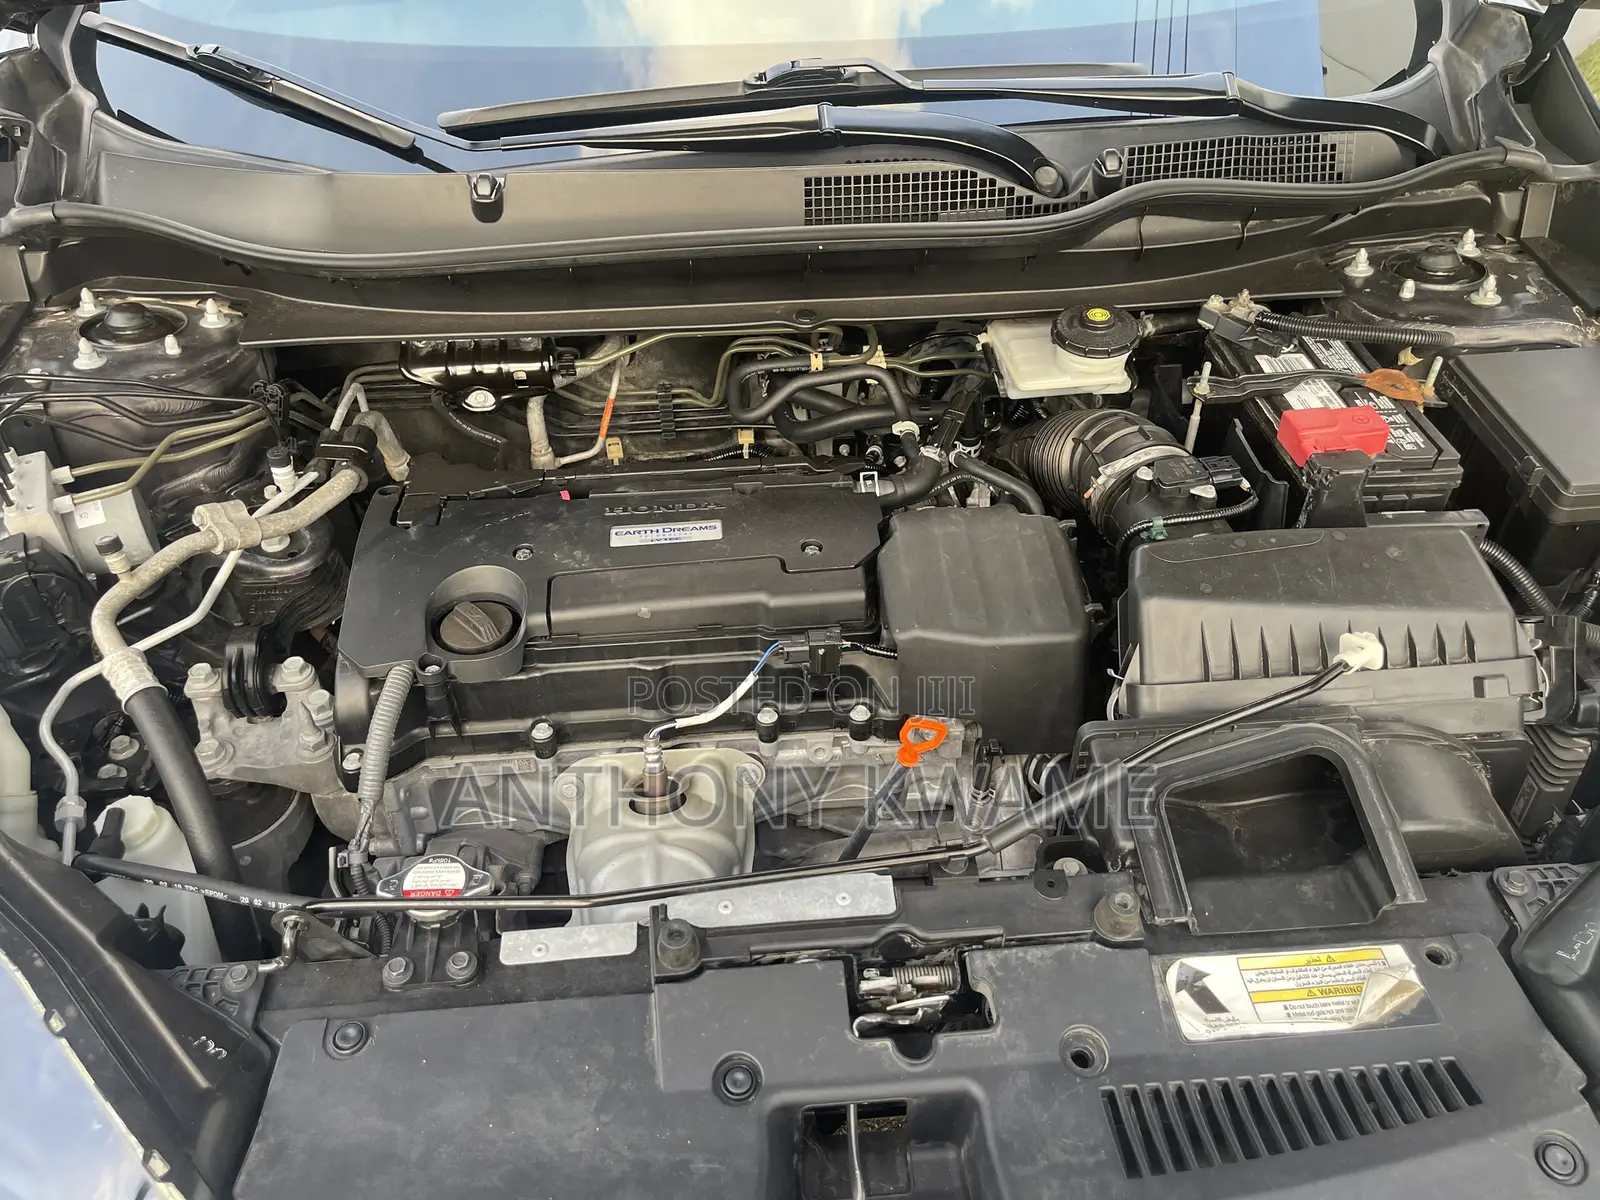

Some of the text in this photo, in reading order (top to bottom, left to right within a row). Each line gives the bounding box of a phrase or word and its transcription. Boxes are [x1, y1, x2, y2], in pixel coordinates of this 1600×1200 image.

[604, 502, 726, 516] HONDA
[614, 524, 718, 537] EARTH DREAMS
[1317, 985, 1363, 996] WARNING
